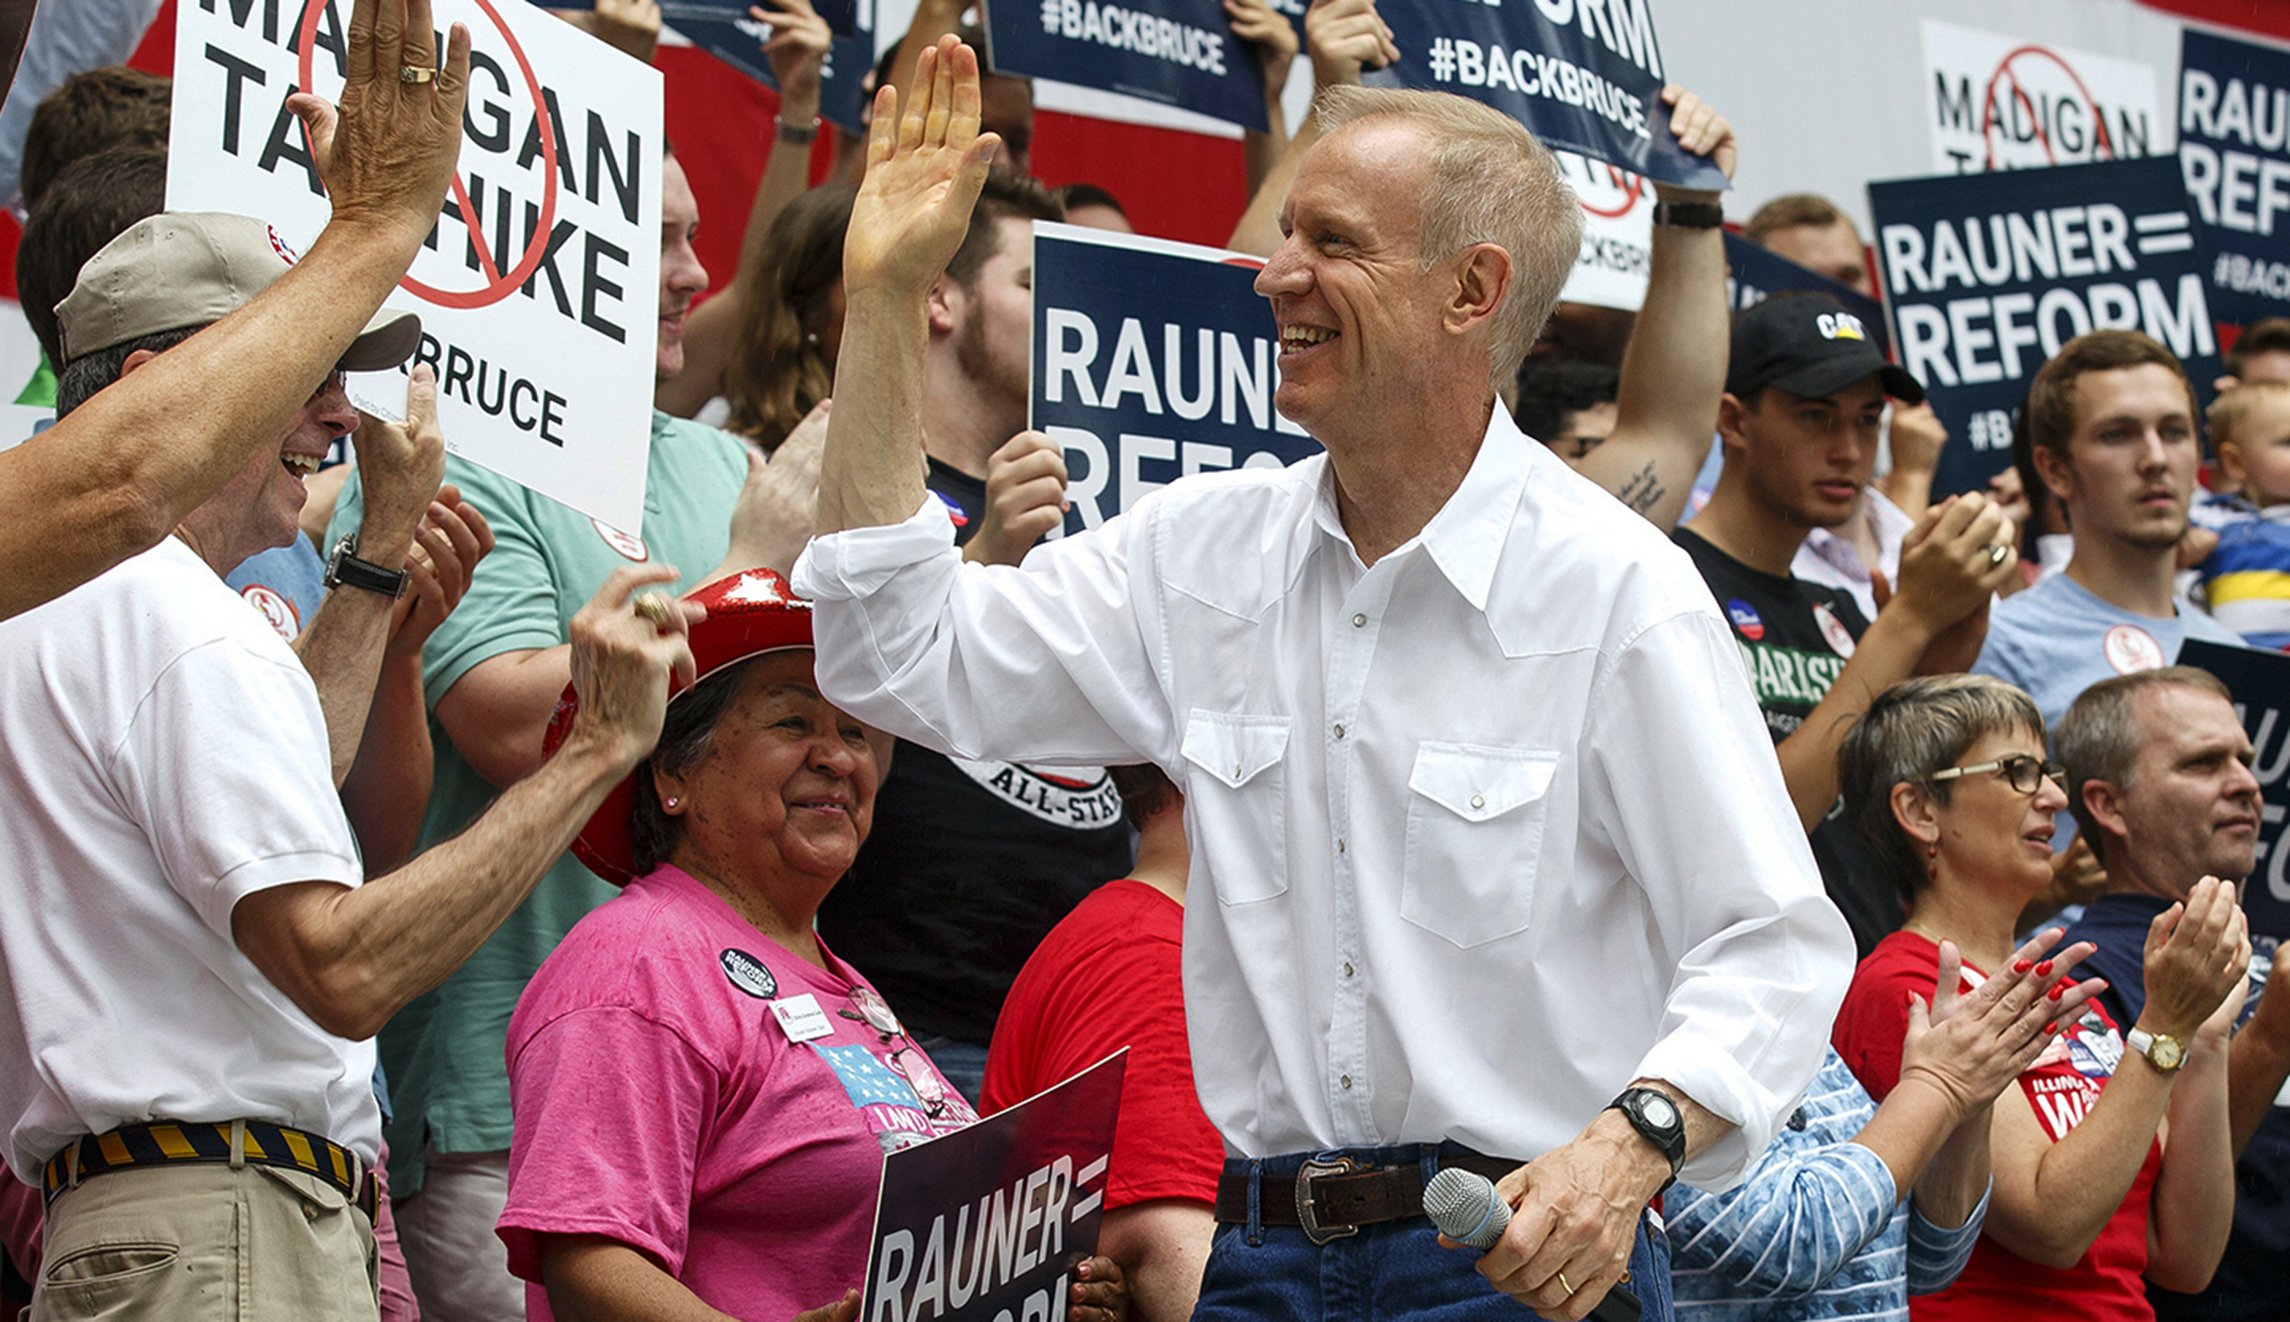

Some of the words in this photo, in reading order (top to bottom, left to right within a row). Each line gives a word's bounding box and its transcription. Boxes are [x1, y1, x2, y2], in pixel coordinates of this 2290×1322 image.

[1040, 0, 1227, 76] #BACKBRUCE
[205, 42, 339, 199] TA
[1429, 37, 1651, 139] #BACKBRUCE
[1935, 70, 2148, 160] MADIGAN
[1816, 312, 1865, 341] CAT
